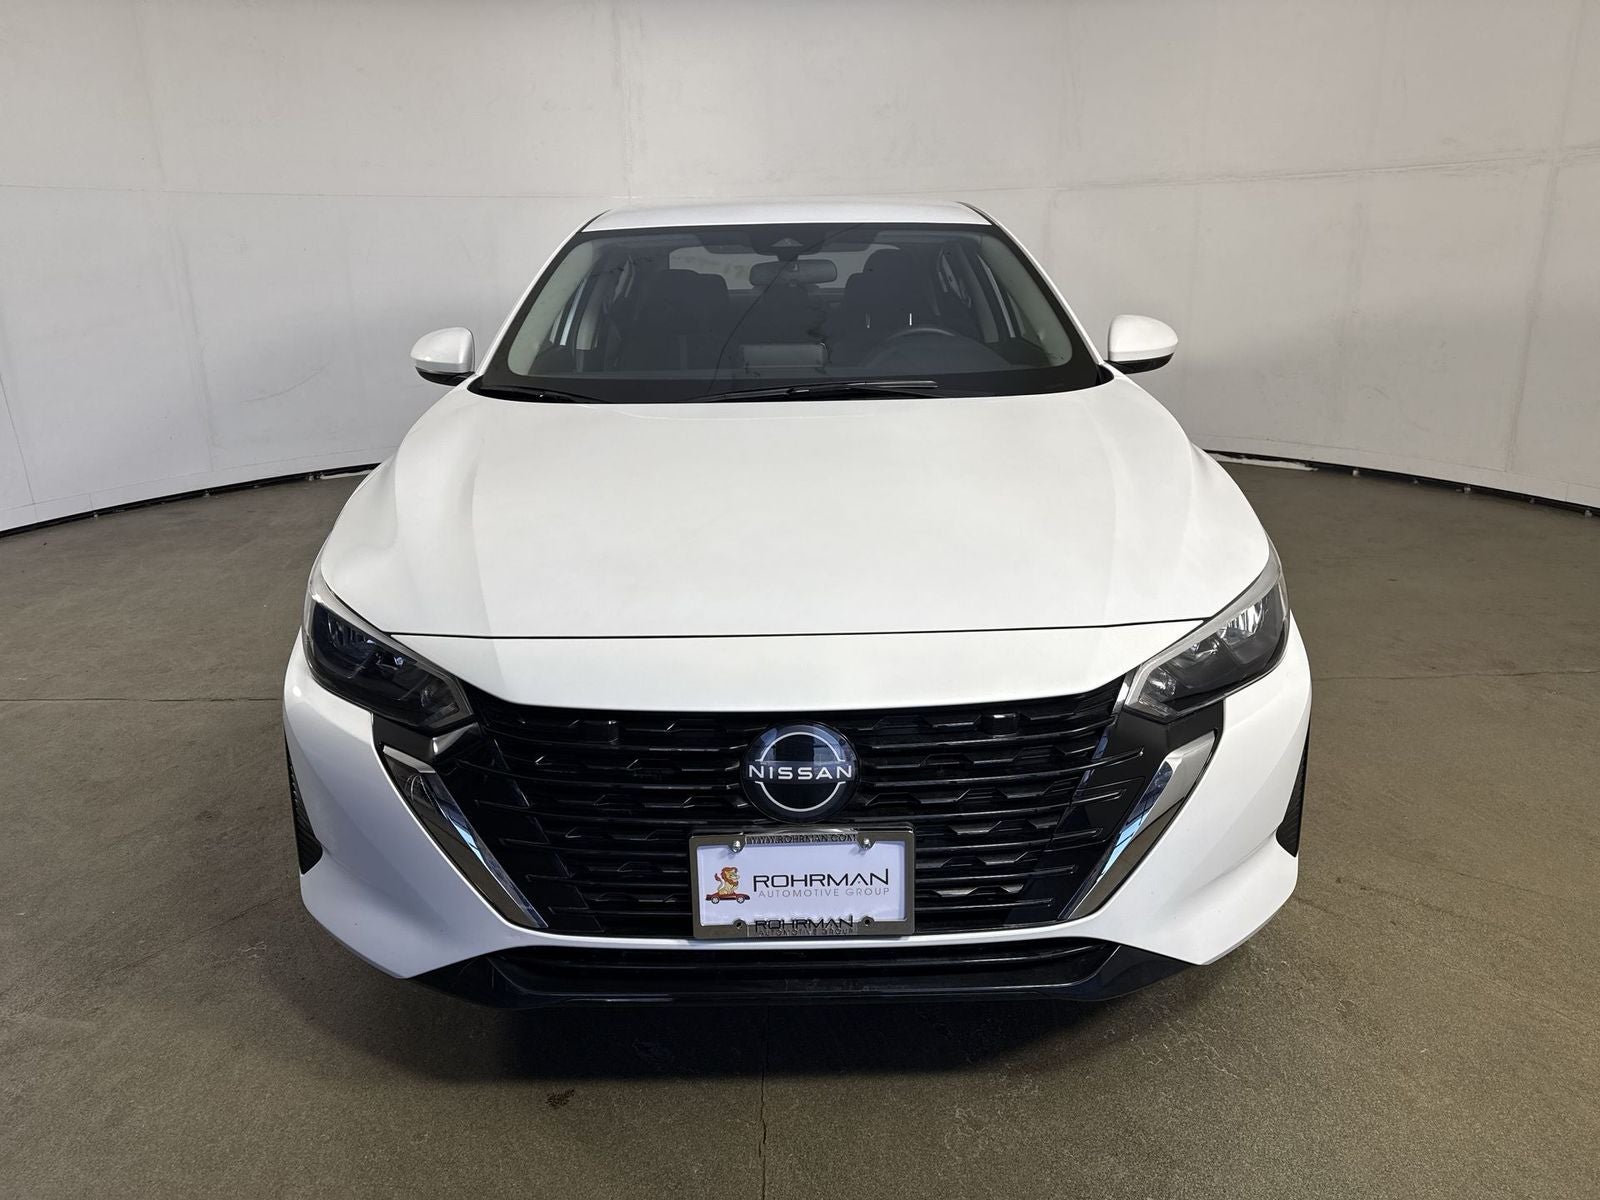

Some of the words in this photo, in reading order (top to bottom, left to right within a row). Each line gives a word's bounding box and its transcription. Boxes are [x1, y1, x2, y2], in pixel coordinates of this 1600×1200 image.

[749, 764, 852, 780] NISSAN
[753, 868, 889, 892] ROHRMAN
[758, 888, 840, 898] AUTOMOTIVE
[846, 887, 890, 897] GROUP
[755, 915, 853, 932] ROHRMAN
